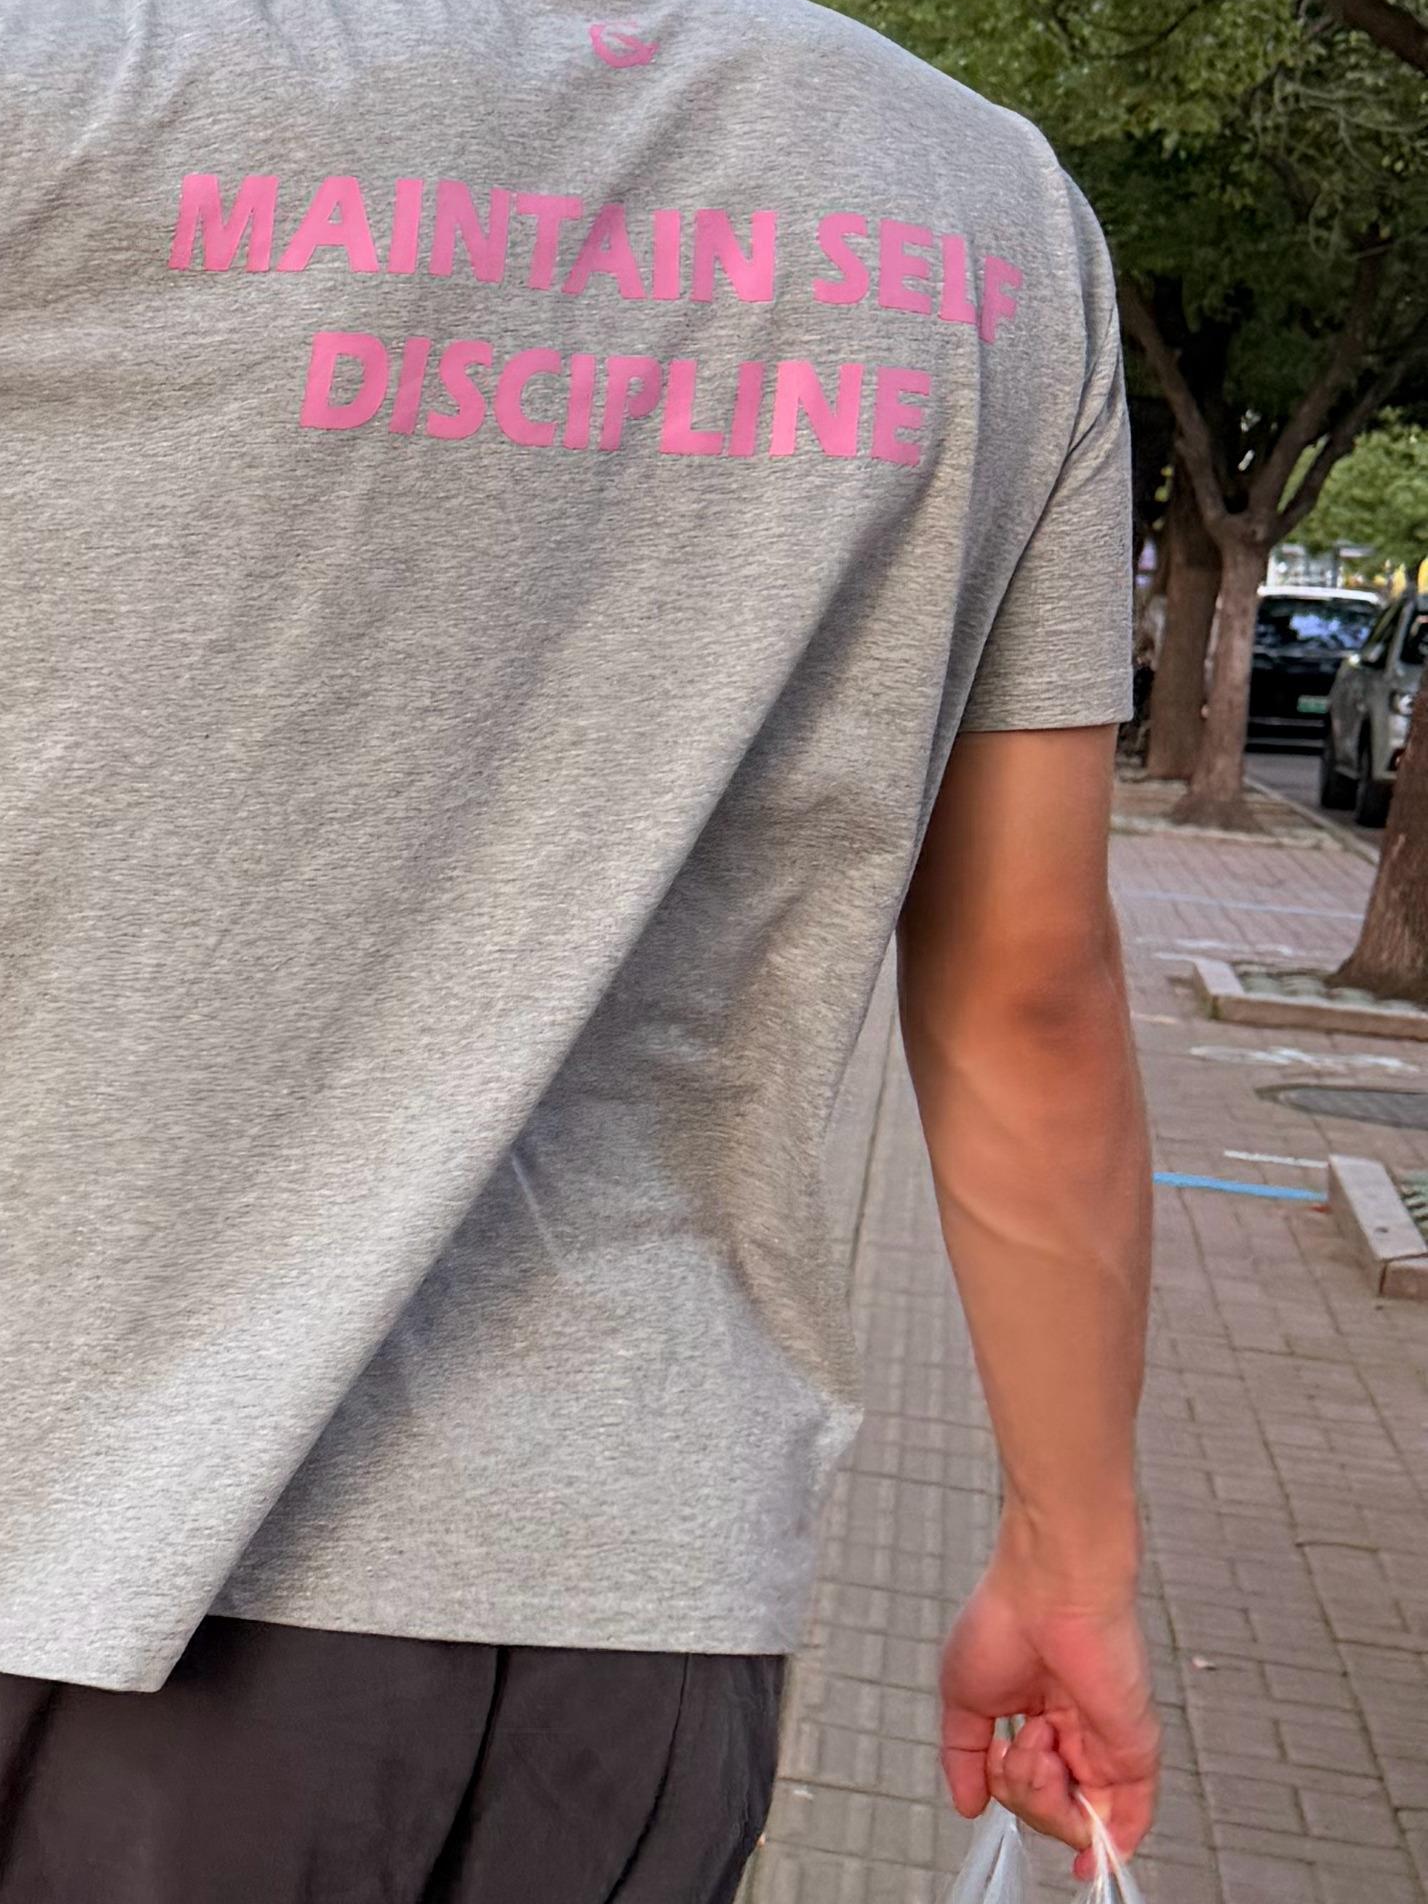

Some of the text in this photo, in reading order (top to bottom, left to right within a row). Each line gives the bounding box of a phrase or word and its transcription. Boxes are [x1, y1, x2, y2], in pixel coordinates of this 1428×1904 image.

[168, 171, 1024, 344] MAINTAIN SELF
[298, 330, 933, 467] DISCIPLINE
